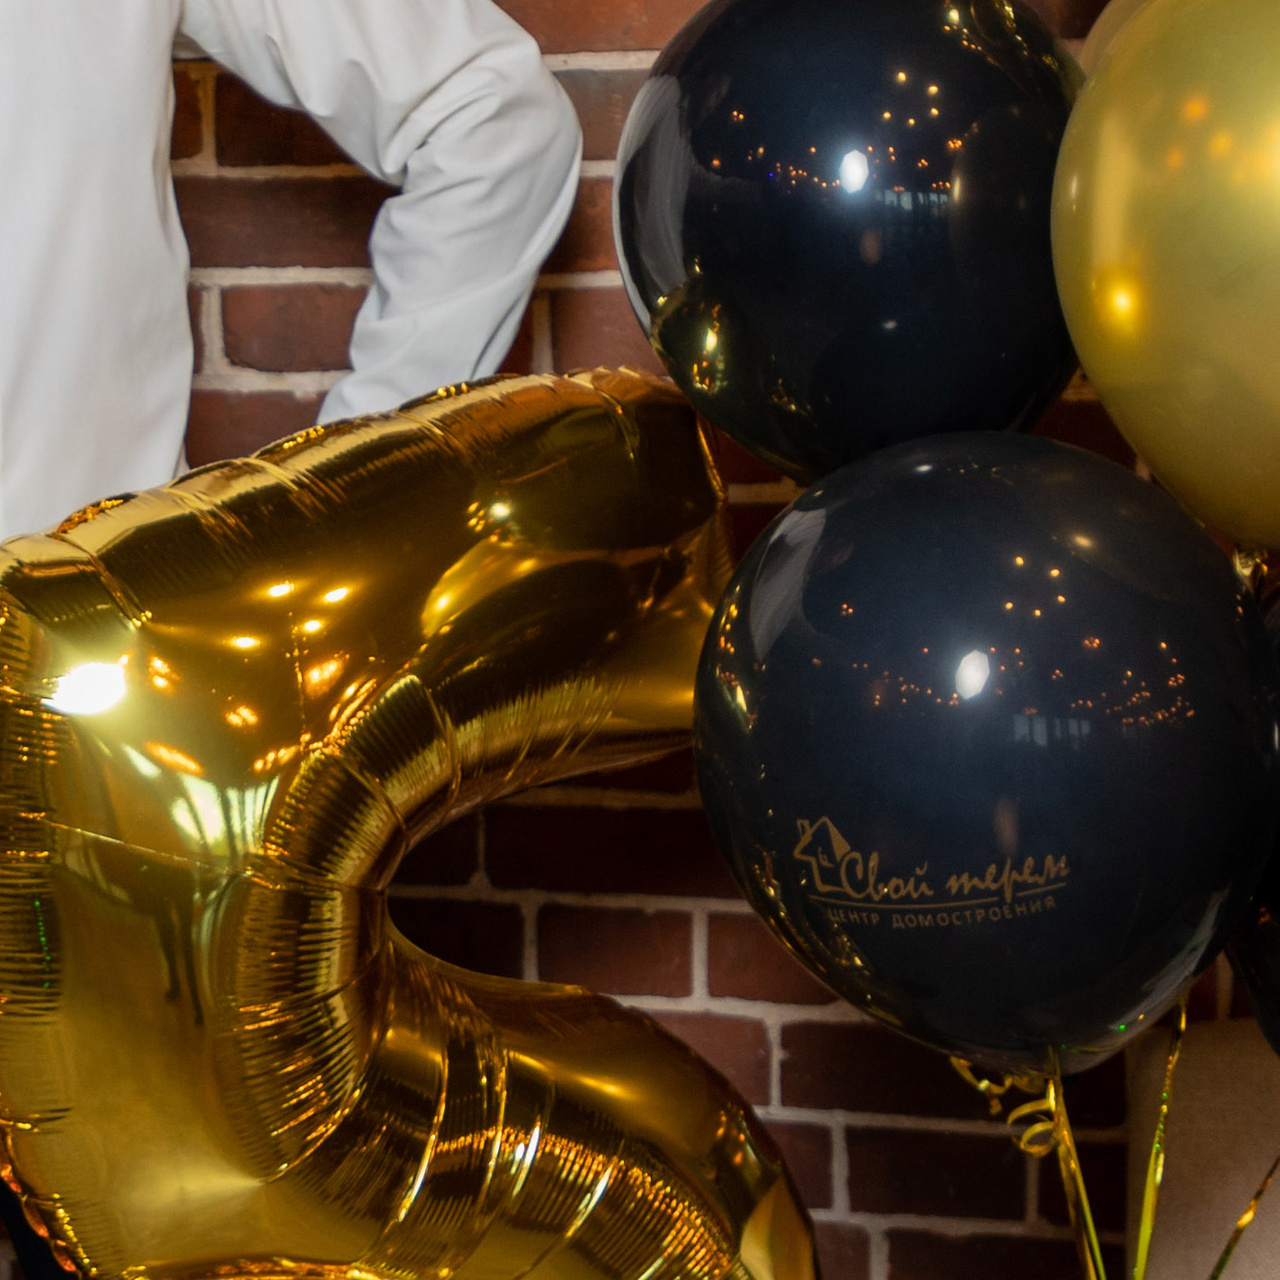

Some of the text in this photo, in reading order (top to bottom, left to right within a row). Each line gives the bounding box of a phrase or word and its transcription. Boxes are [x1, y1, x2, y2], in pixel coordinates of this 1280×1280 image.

[841, 851, 1070, 904] Свой терем
[827, 894, 1057, 929] ЦЕНТР ДОМОСТРОЕНИЯ
